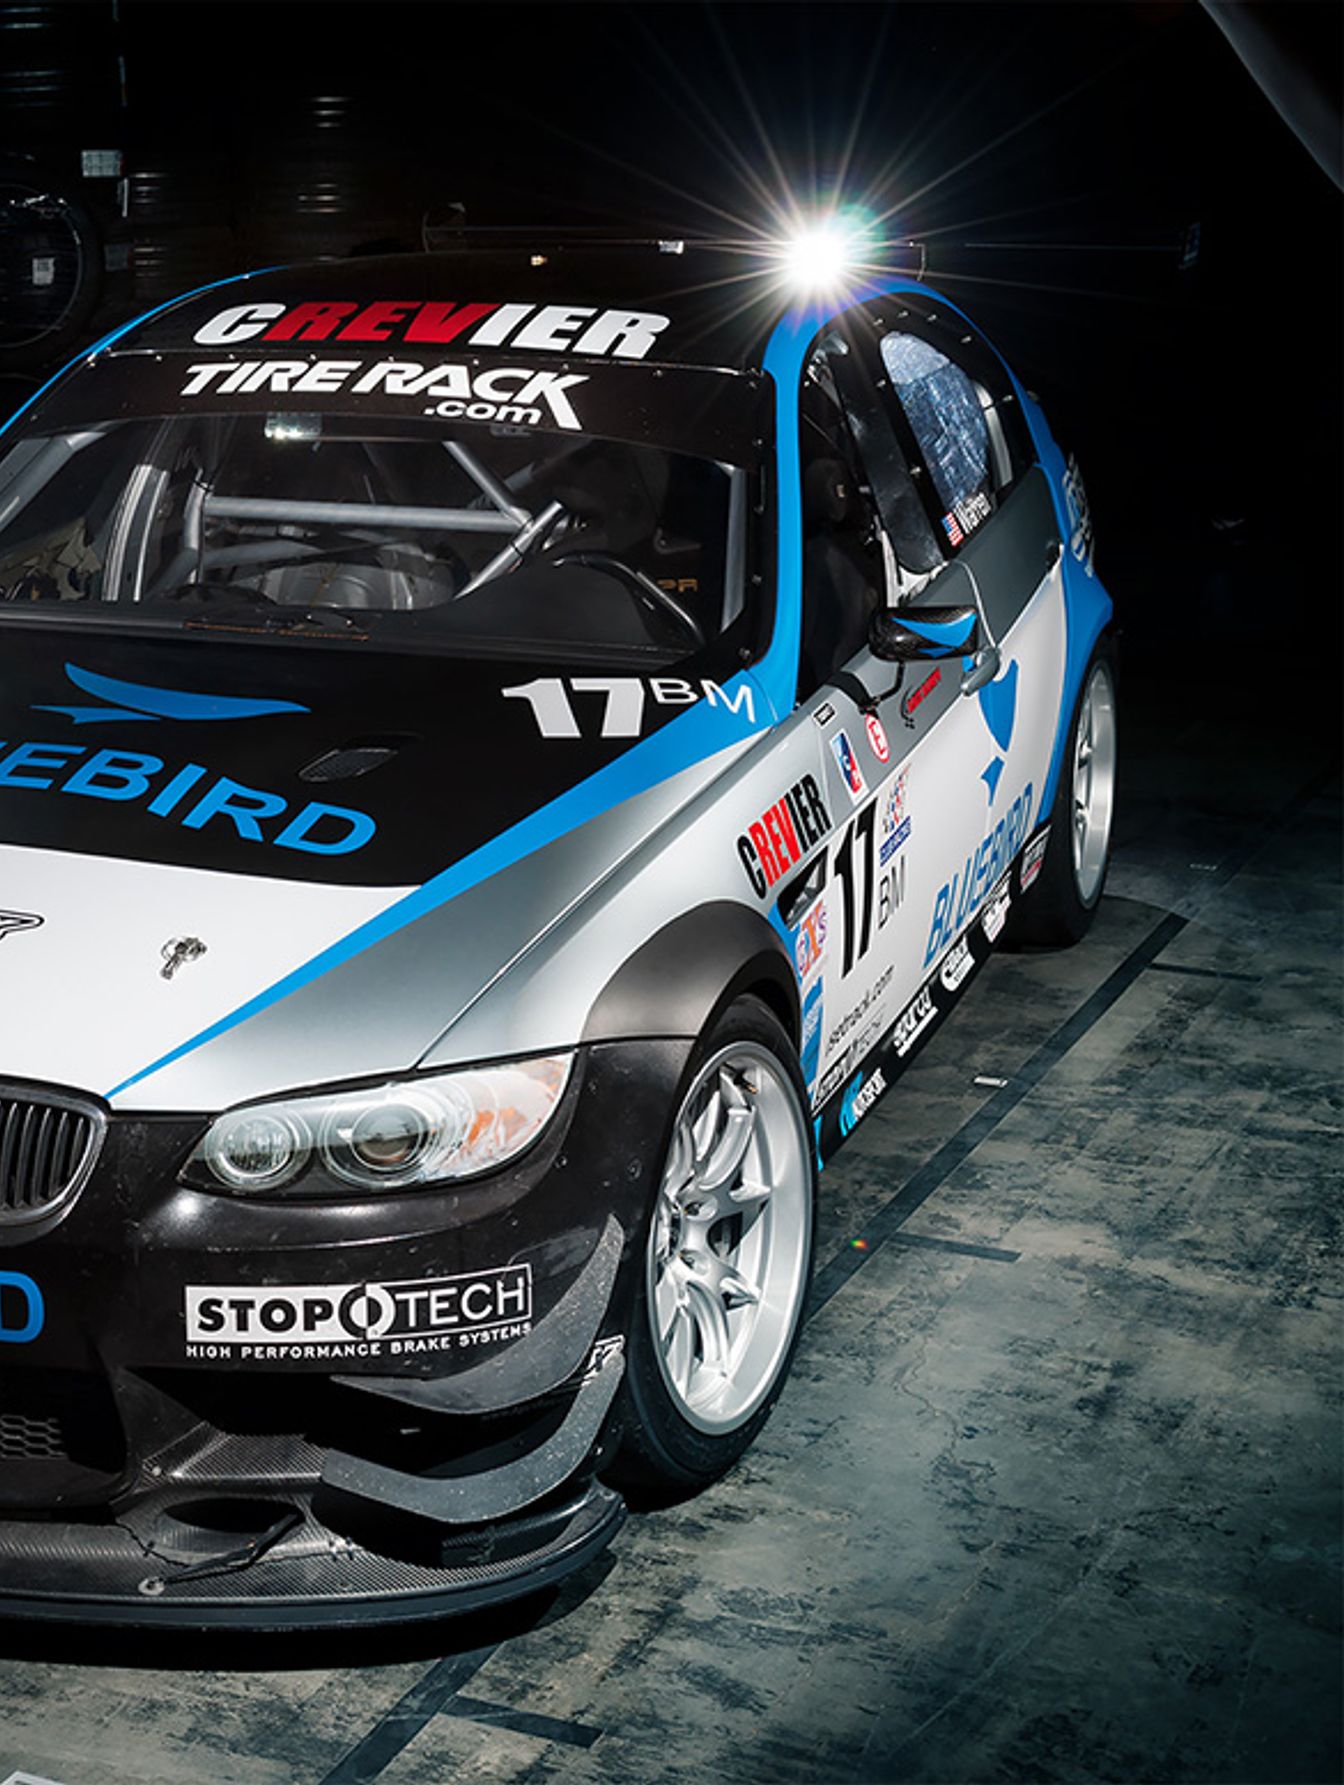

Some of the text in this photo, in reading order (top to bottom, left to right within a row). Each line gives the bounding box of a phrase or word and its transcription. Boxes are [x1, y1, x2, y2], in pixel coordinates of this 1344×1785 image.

[193, 301, 671, 360] CREVIER
[424, 401, 542, 425] .com
[501, 677, 645, 738] 17
[648, 677, 756, 724] BM
[736, 773, 833, 900] CREVIER
[833, 796, 878, 979] 17
[922, 782, 1033, 969] BLUEBIRD
[186, 1322, 532, 1360] HIGH PERFORMANCE BRAKE SYSTEMS
